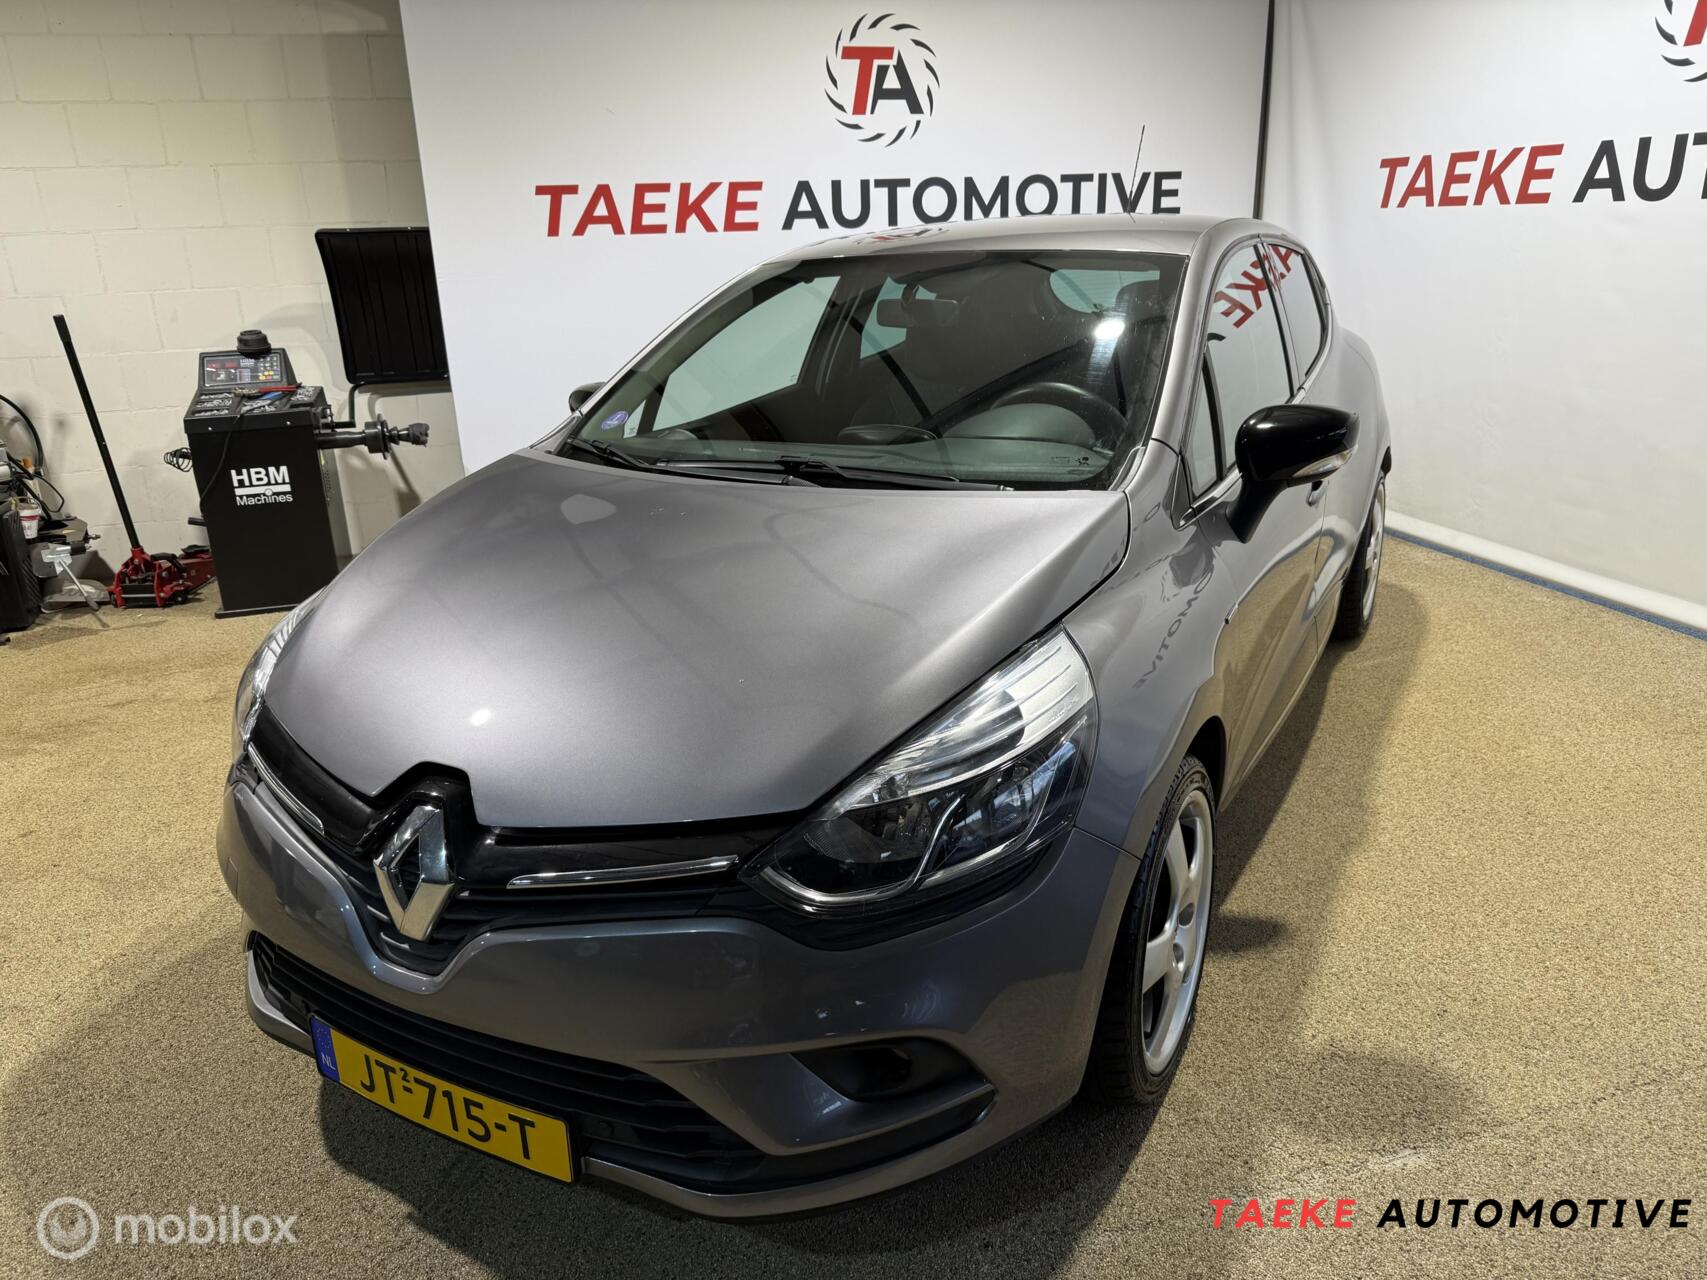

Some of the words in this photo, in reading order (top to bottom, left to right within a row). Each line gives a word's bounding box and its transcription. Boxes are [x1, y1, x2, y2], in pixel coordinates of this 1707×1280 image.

[840, 45, 924, 116] TA
[1379, 143, 1564, 208] TAEKE
[534, 180, 763, 237] TAEKE
[781, 170, 1183, 230] AUTOMOTIVE
[230, 465, 290, 487] HBM
[236, 494, 293, 506] Machines
[321, 1052, 336, 1070] NL
